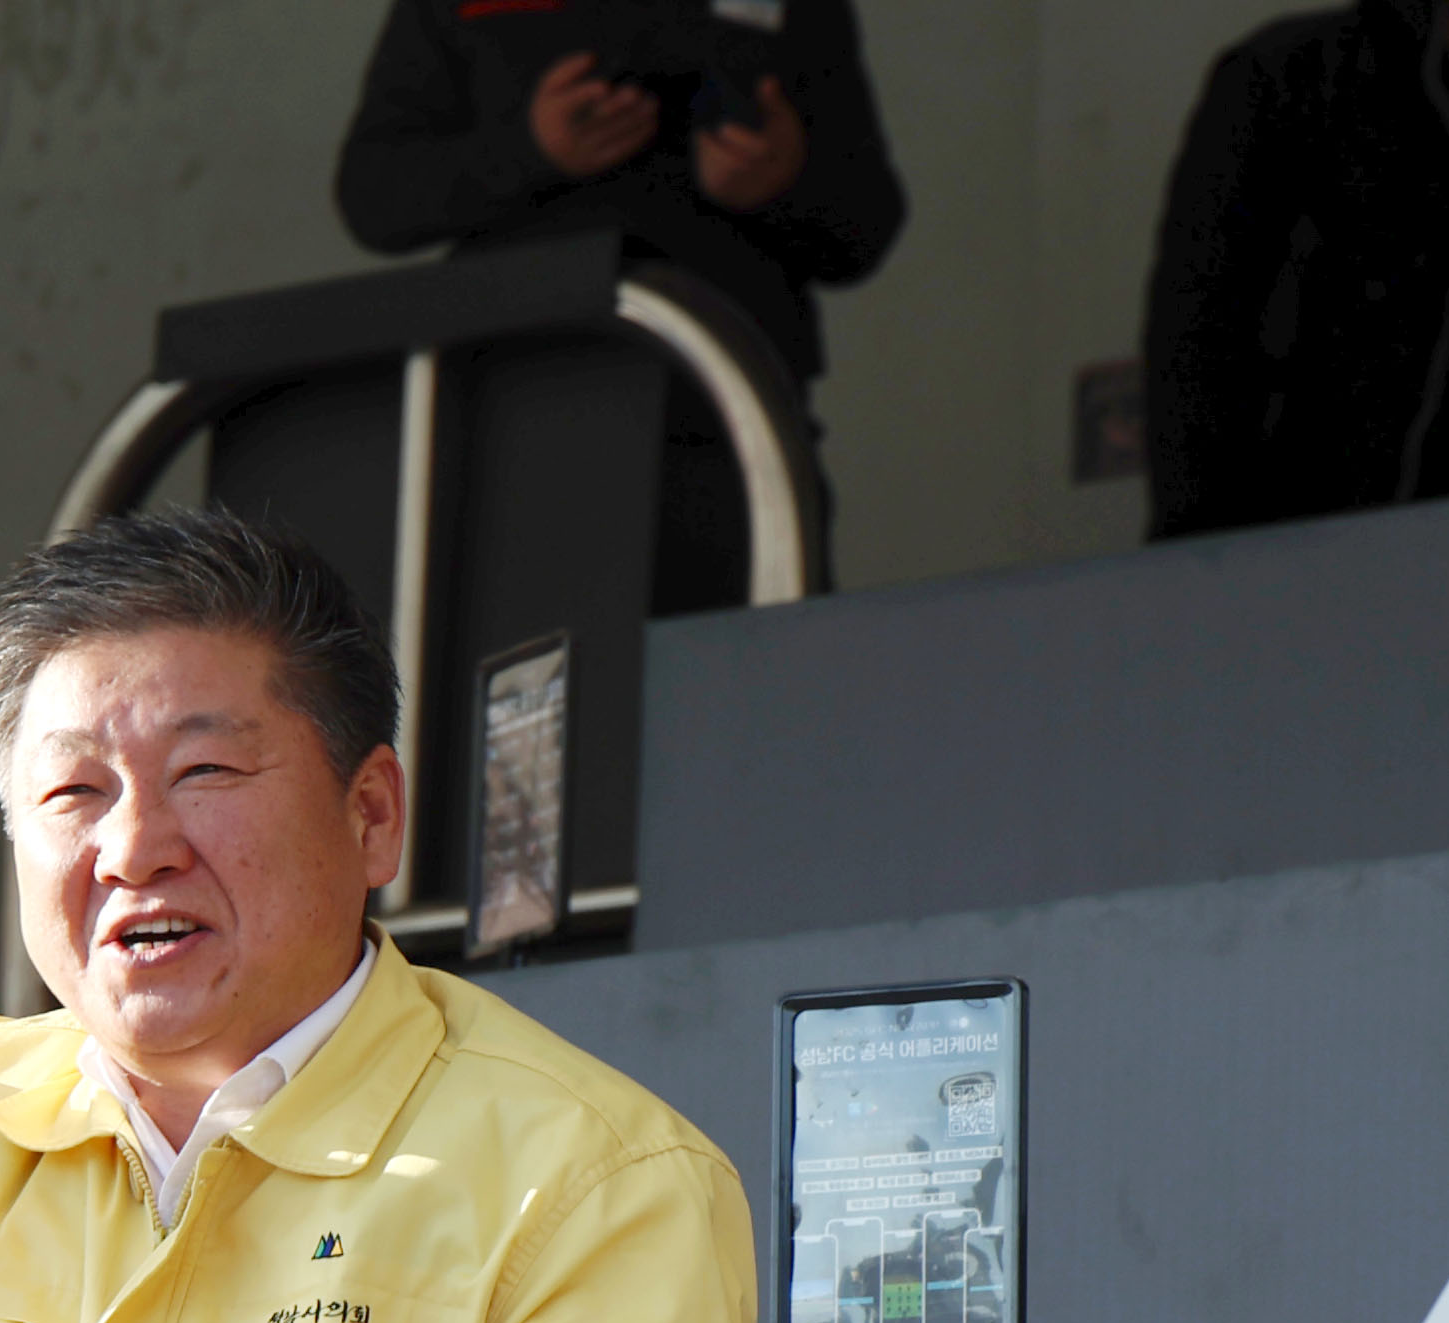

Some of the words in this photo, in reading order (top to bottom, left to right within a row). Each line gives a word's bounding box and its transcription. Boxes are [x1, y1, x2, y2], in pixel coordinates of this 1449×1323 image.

[800, 1044, 856, 1067] 성남FC
[860, 1040, 895, 1062] 공식
[899, 1032, 1000, 1059] 어플리케이션
